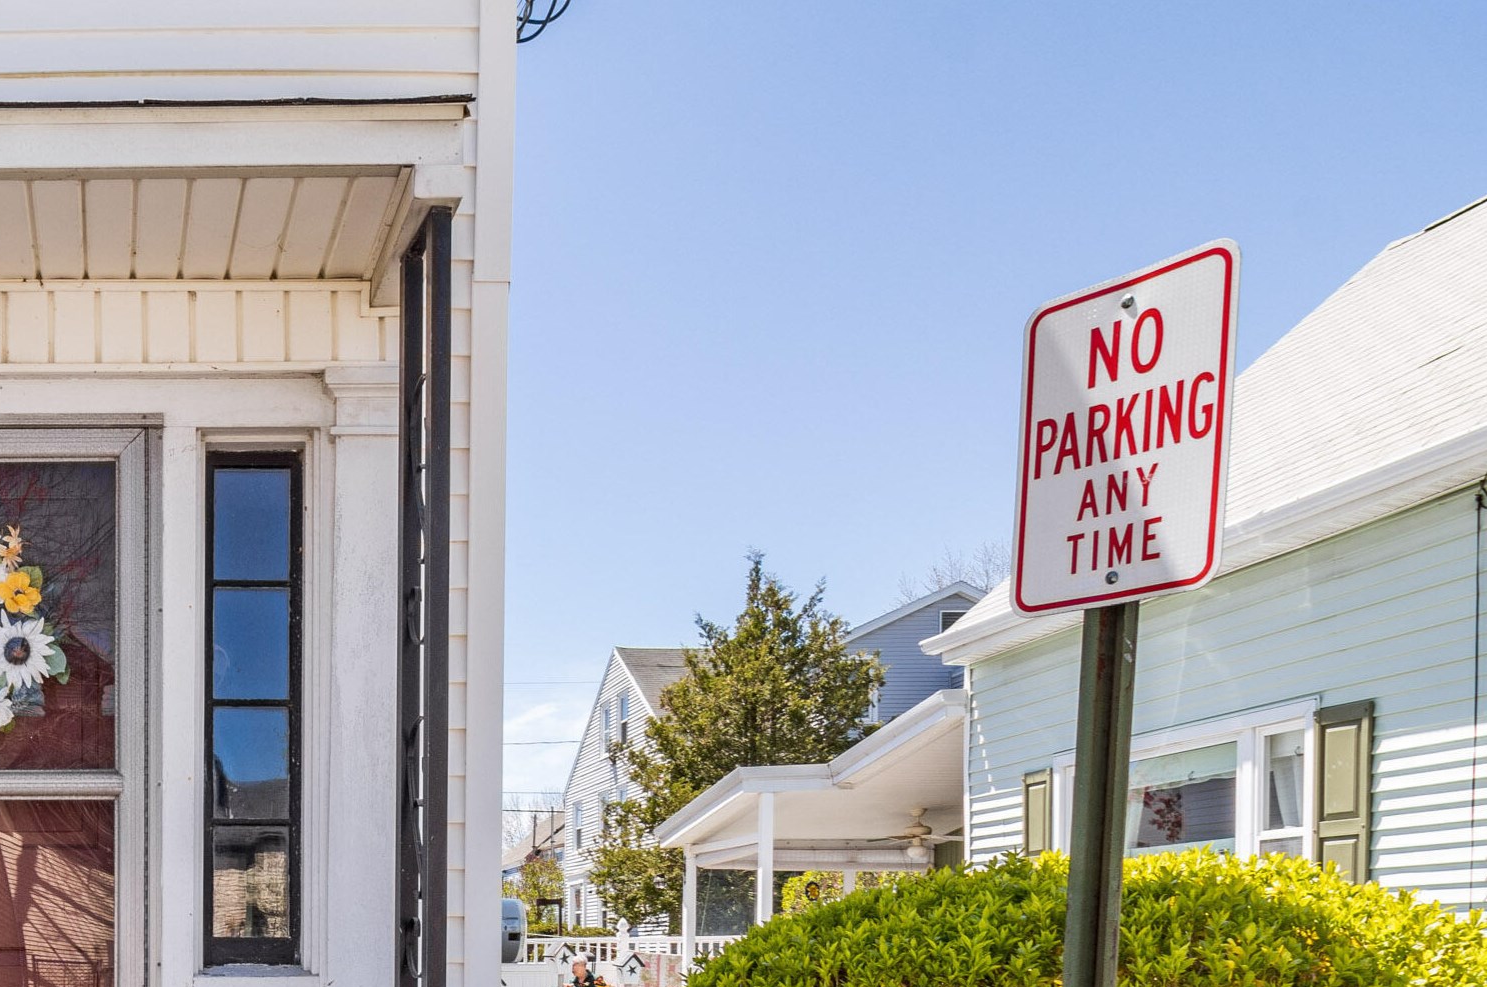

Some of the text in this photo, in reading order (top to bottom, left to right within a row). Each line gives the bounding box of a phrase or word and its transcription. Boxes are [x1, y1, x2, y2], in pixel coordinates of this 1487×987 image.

[1087, 307, 1164, 389] NO
[1033, 371, 1215, 480] PARKING
[1076, 462, 1160, 522] ANY
[1066, 516, 1163, 575] TIME
